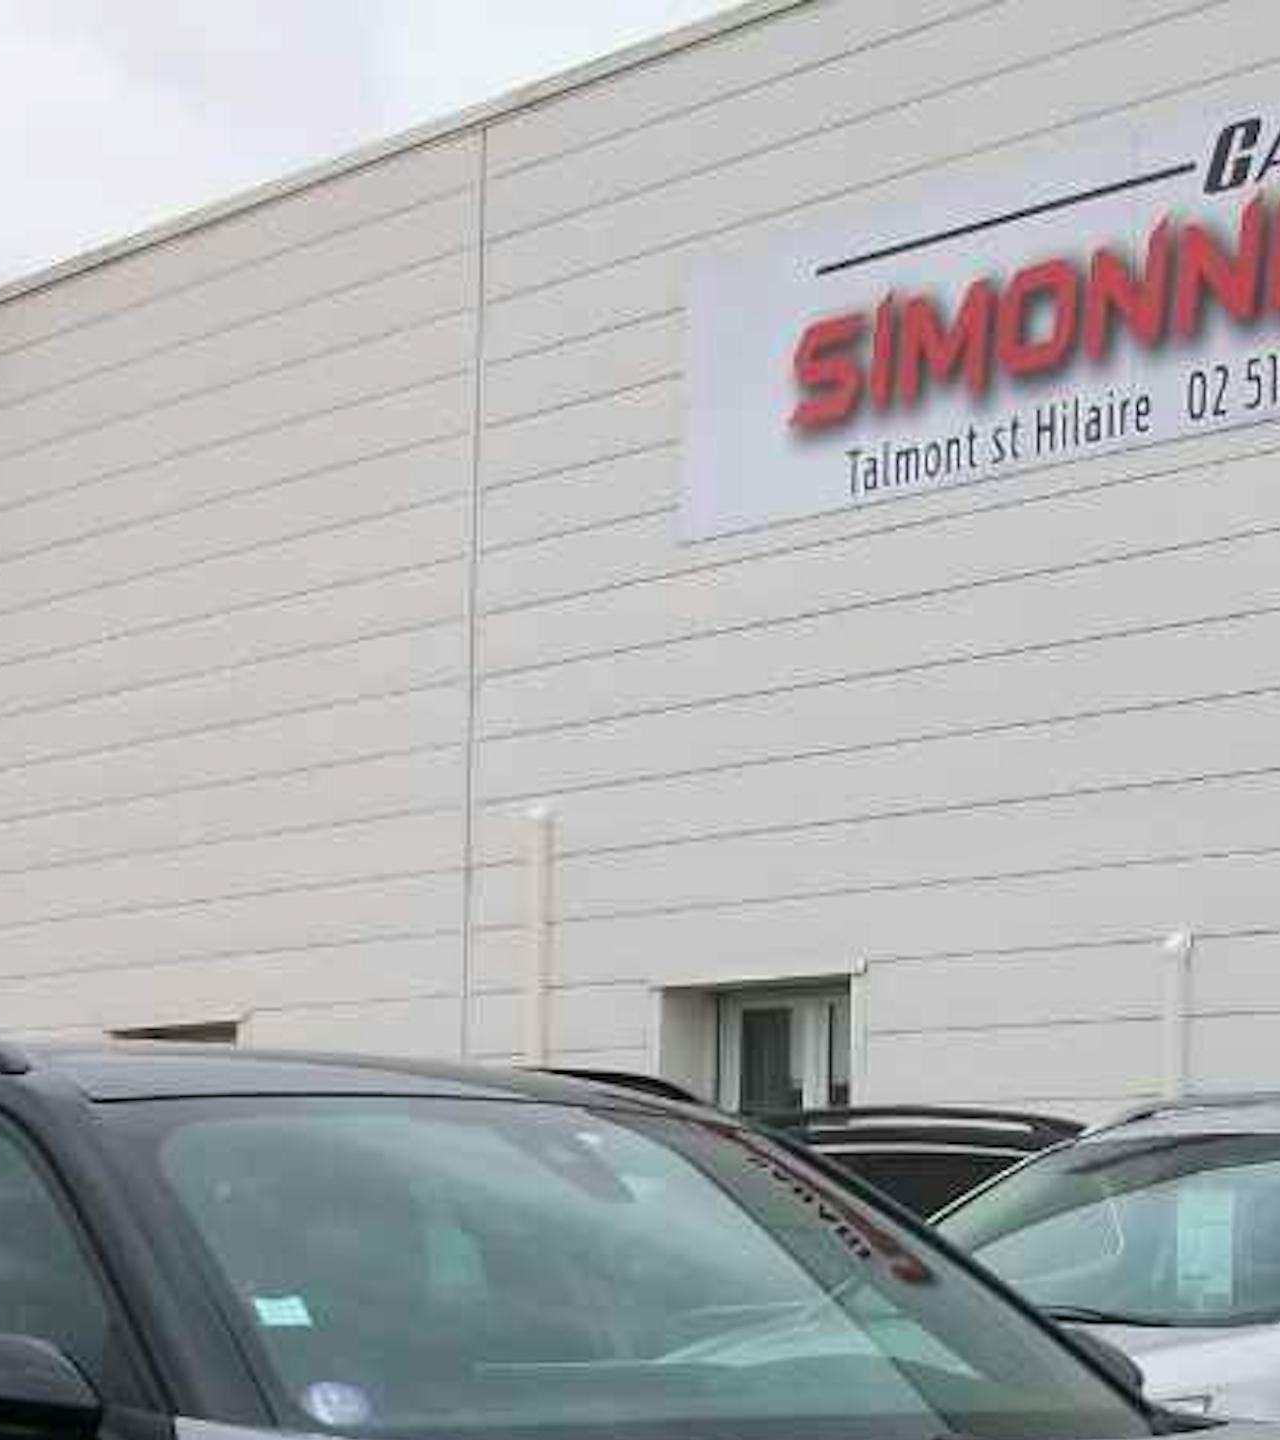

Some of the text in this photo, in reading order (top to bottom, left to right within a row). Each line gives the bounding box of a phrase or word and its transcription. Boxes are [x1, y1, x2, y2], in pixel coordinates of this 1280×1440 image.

[845, 423, 977, 494] Talmont
[991, 414, 1021, 464] st
[1035, 390, 1151, 454] Hilaire
[1187, 365, 1229, 420] 02
[1245, 353, 1278, 409] 51
